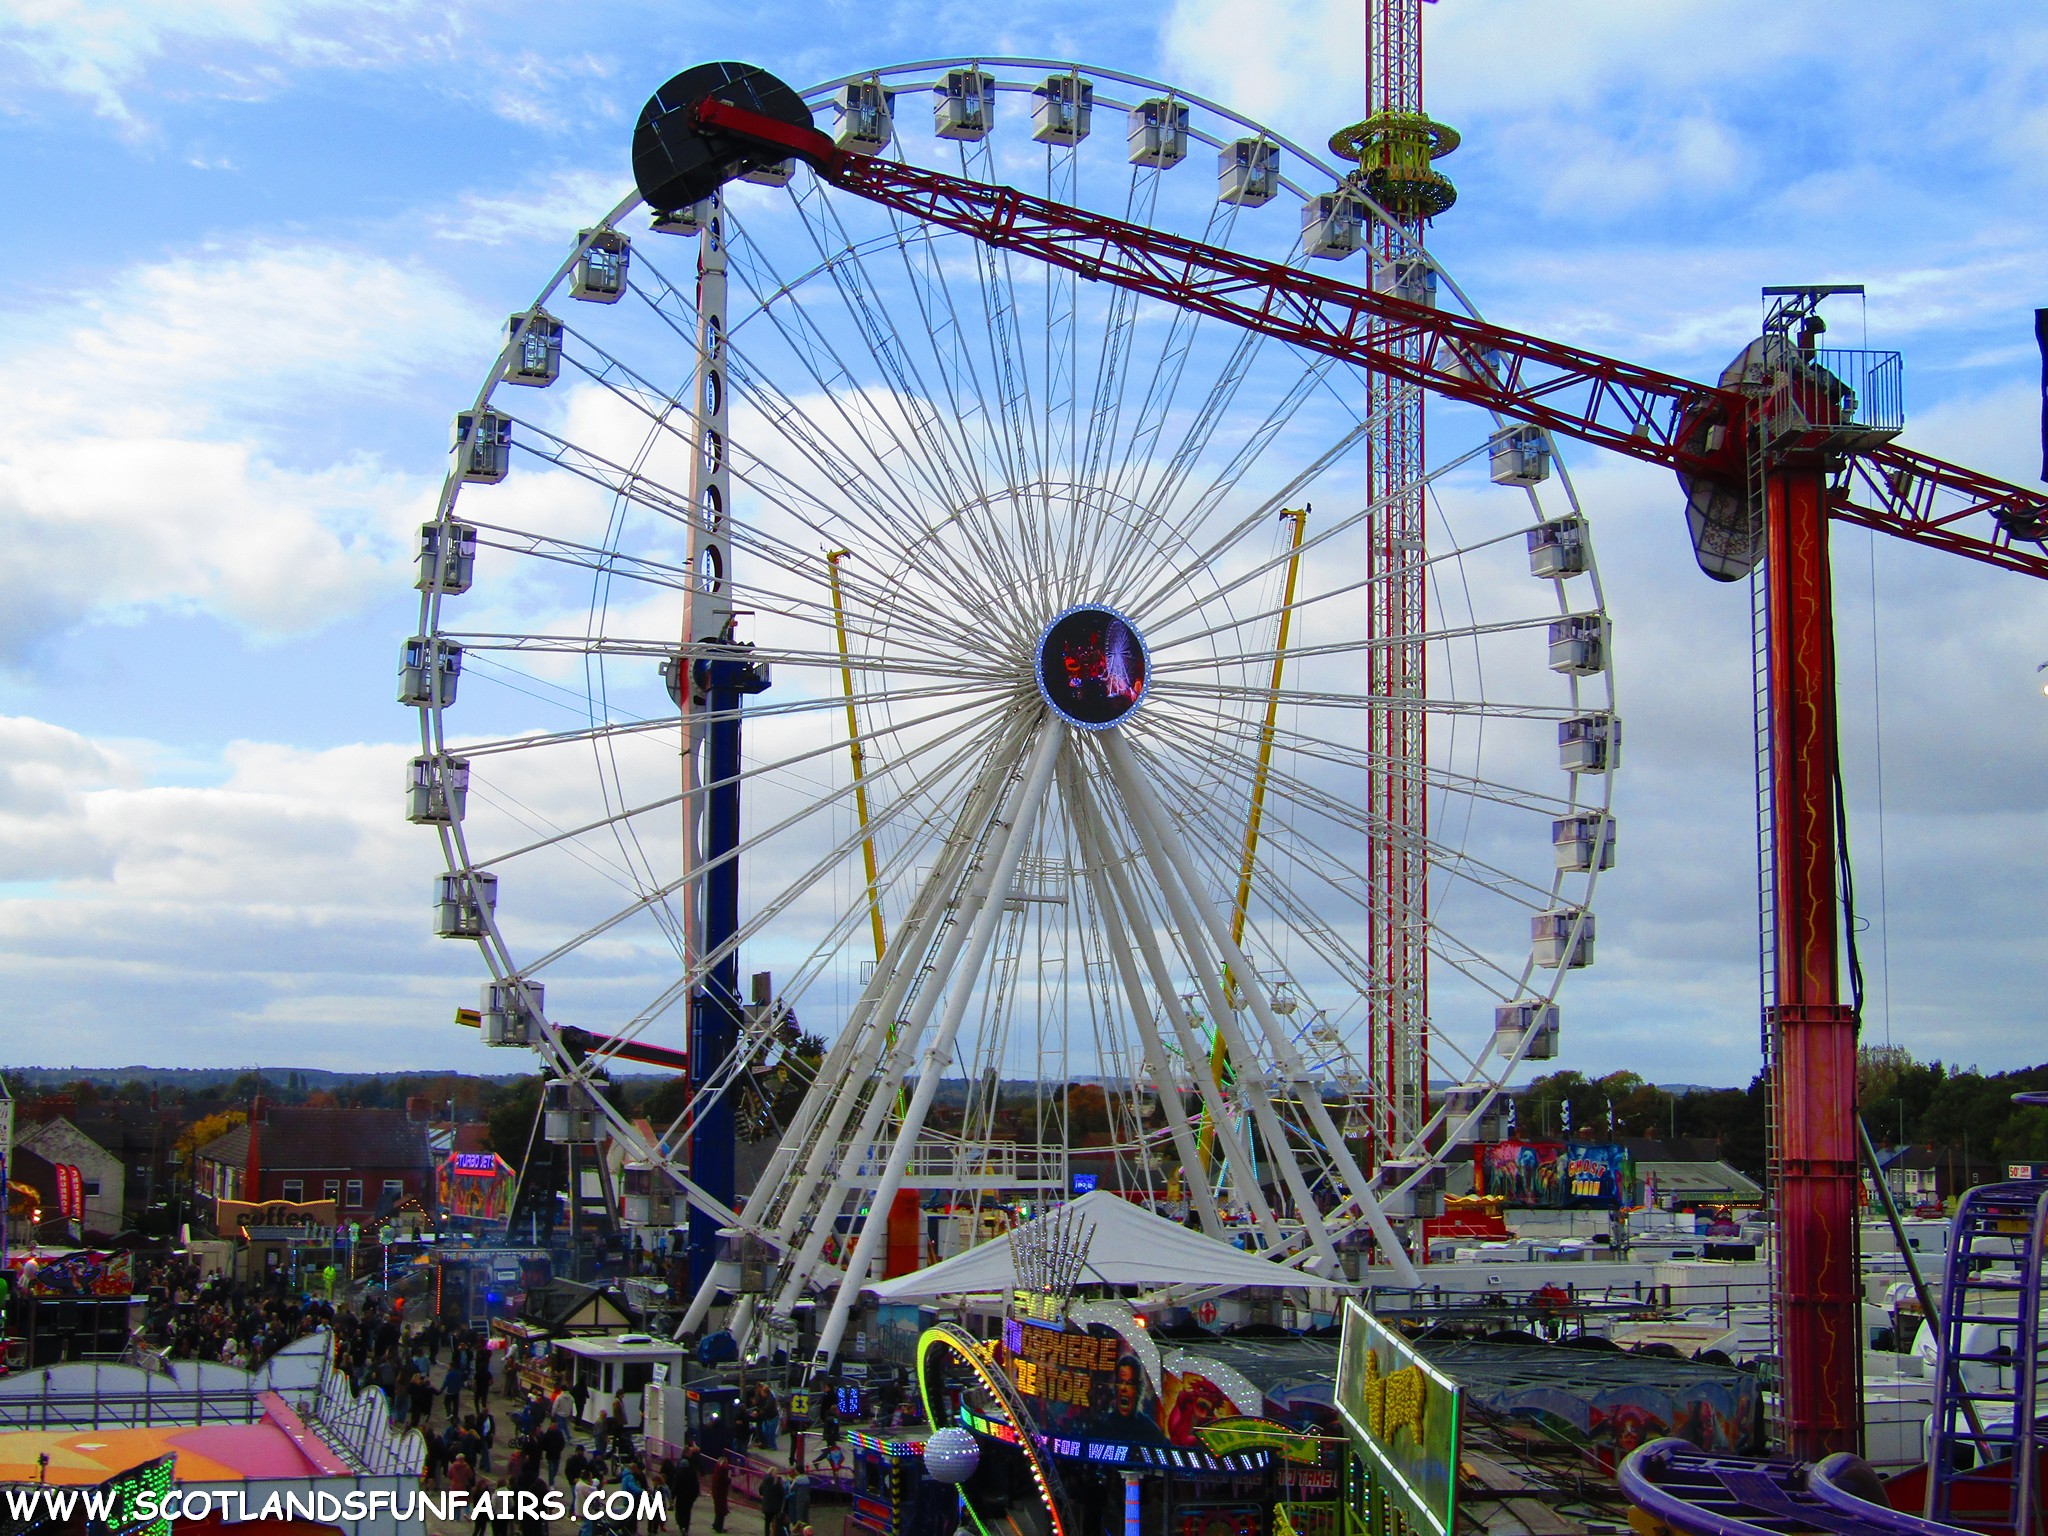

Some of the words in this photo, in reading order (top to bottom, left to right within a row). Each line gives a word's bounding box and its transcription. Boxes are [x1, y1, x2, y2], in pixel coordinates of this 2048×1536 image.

[459, 1154, 480, 1168] TURBO
[480, 1155, 491, 1169] JET
[1568, 1159, 1606, 1178] GHOST
[1571, 1179, 1600, 1196] TRAIN
[236, 1206, 313, 1226] coffee
[791, 1395, 809, 1414] £3
[1054, 1438, 1080, 1456] FOR
[1088, 1443, 1128, 1461] WAR
[1298, 1469, 1332, 1488] TAKE
